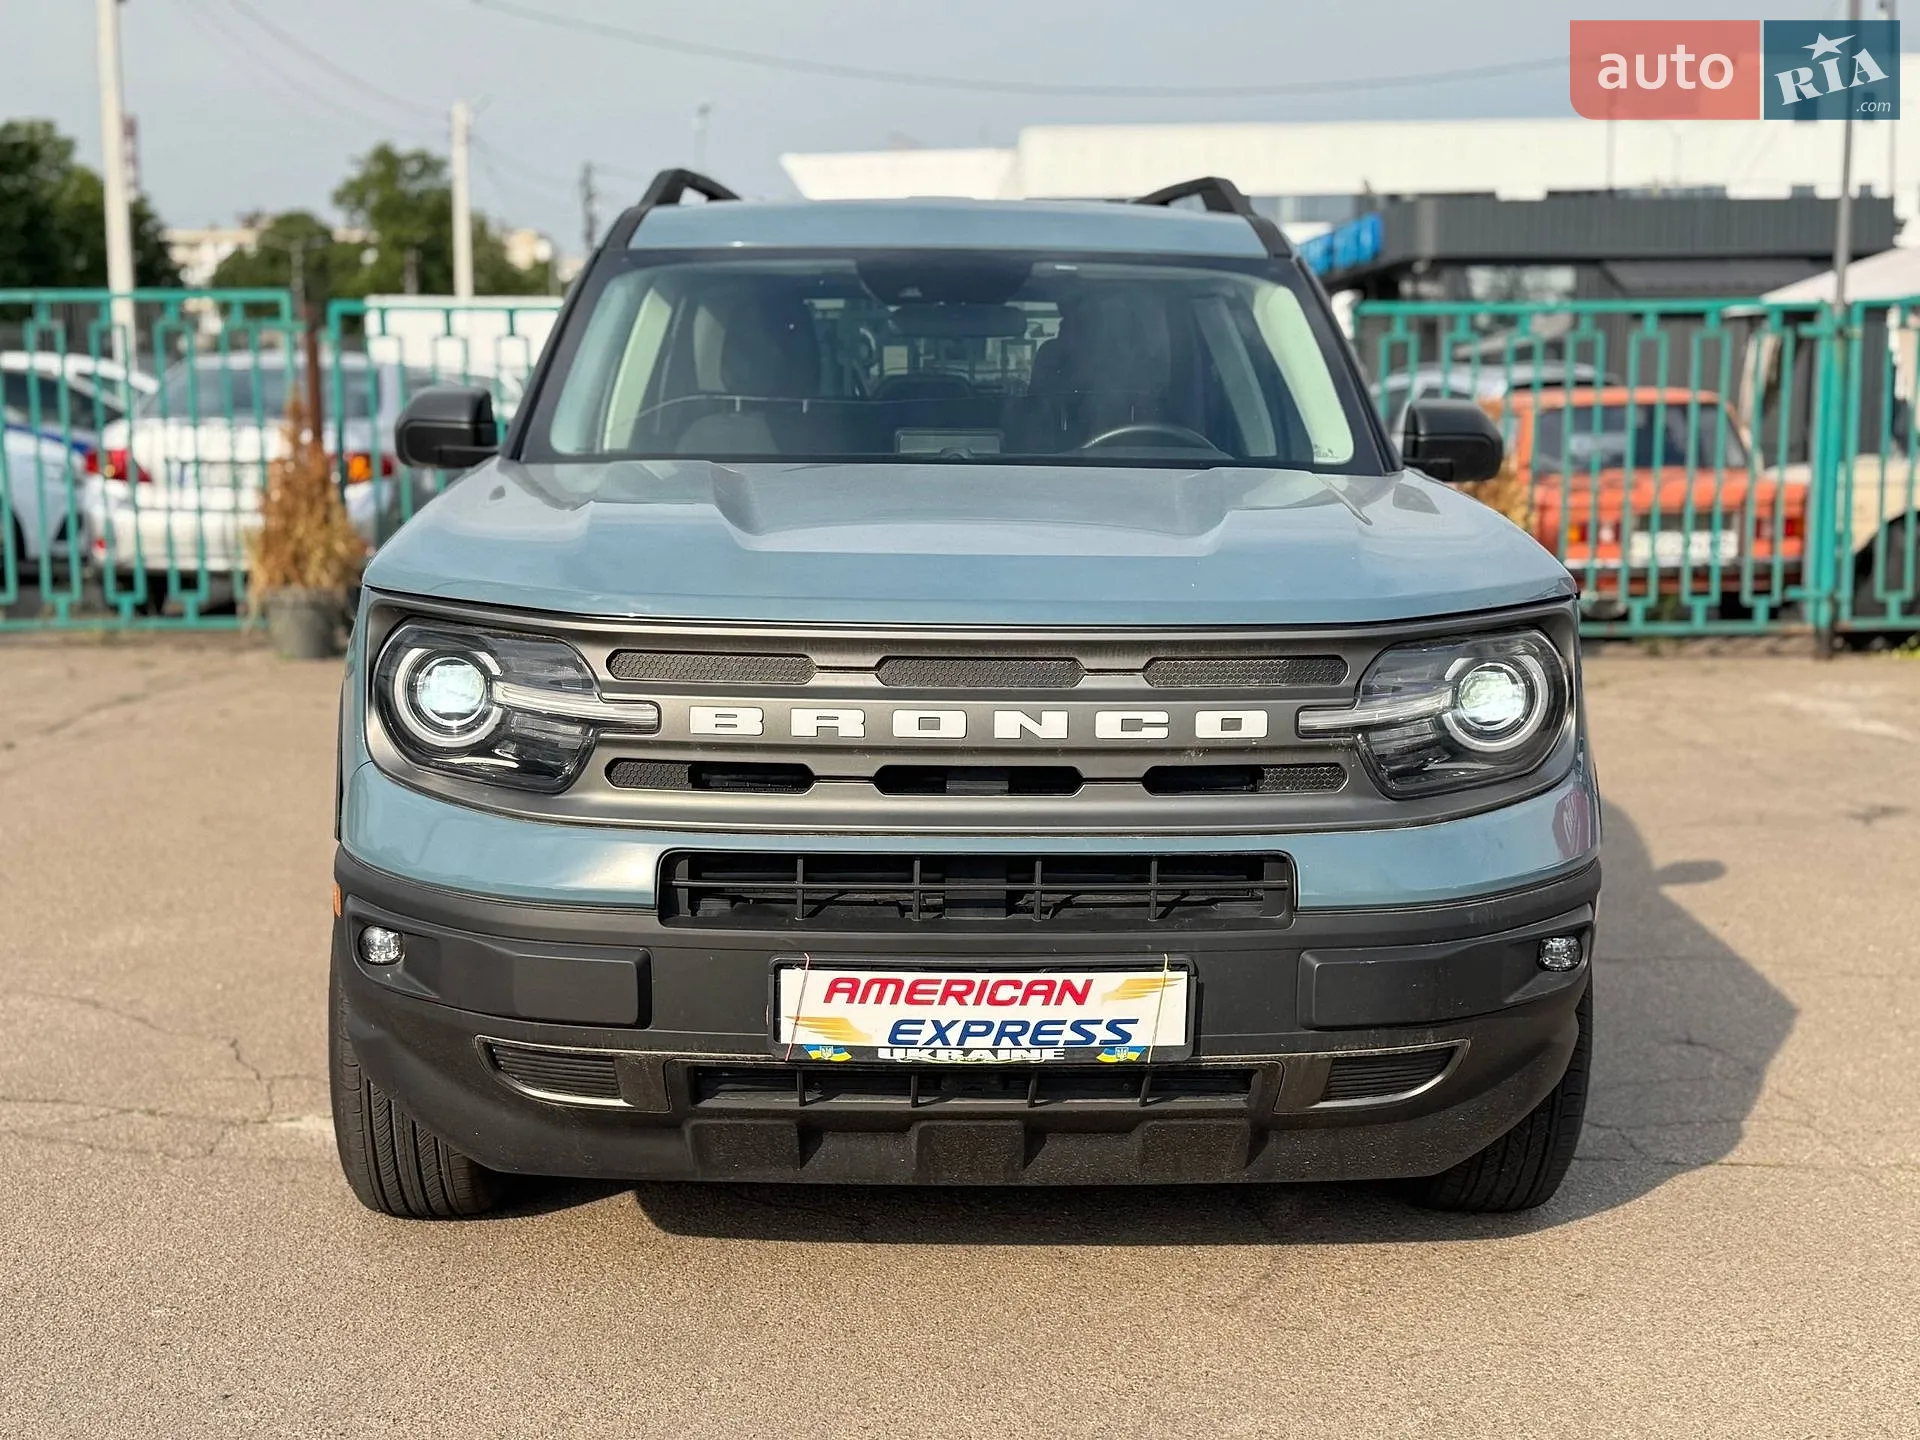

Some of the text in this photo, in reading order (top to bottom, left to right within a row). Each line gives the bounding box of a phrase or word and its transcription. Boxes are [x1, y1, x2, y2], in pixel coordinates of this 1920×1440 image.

[689, 706, 1269, 740] BRONCO
[823, 977, 1094, 1006] AMERICAN
[887, 1018, 1140, 1046] EXPRESS
[877, 1047, 1066, 1060] UKRAINE
